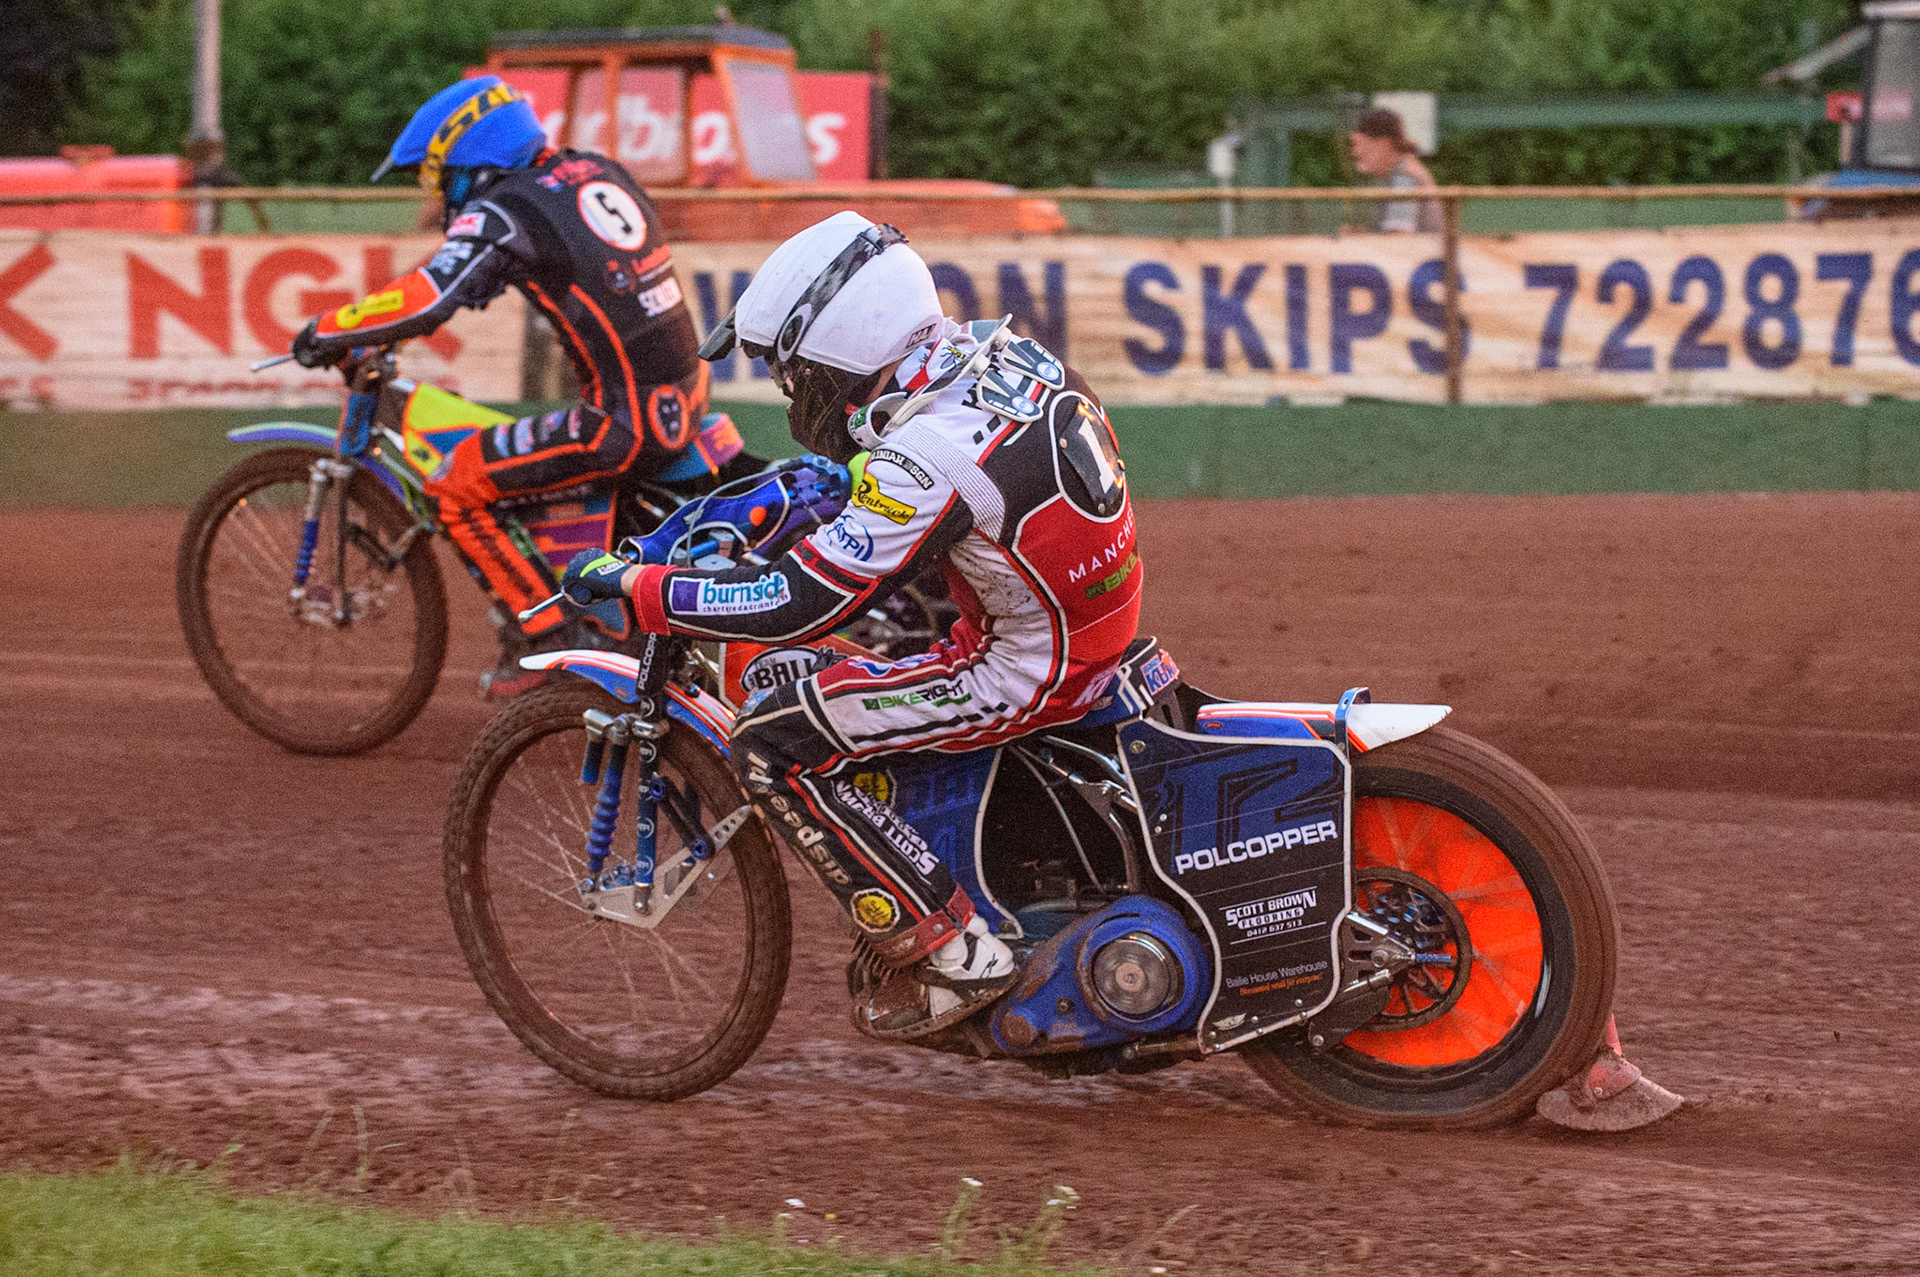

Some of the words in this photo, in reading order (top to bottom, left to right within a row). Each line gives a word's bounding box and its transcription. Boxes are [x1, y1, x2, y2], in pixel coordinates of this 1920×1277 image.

[1123, 259, 1470, 375] SKIPS
[854, 480, 910, 520] Rentruck
[1174, 819, 1339, 875] POLCOPPER
[1225, 902, 1265, 926] SCOTT
[1267, 889, 1317, 911] BROWN
[1241, 908, 1301, 928] FLOORING
[1250, 969, 1279, 984] House
[1278, 960, 1328, 978] Warehouse
